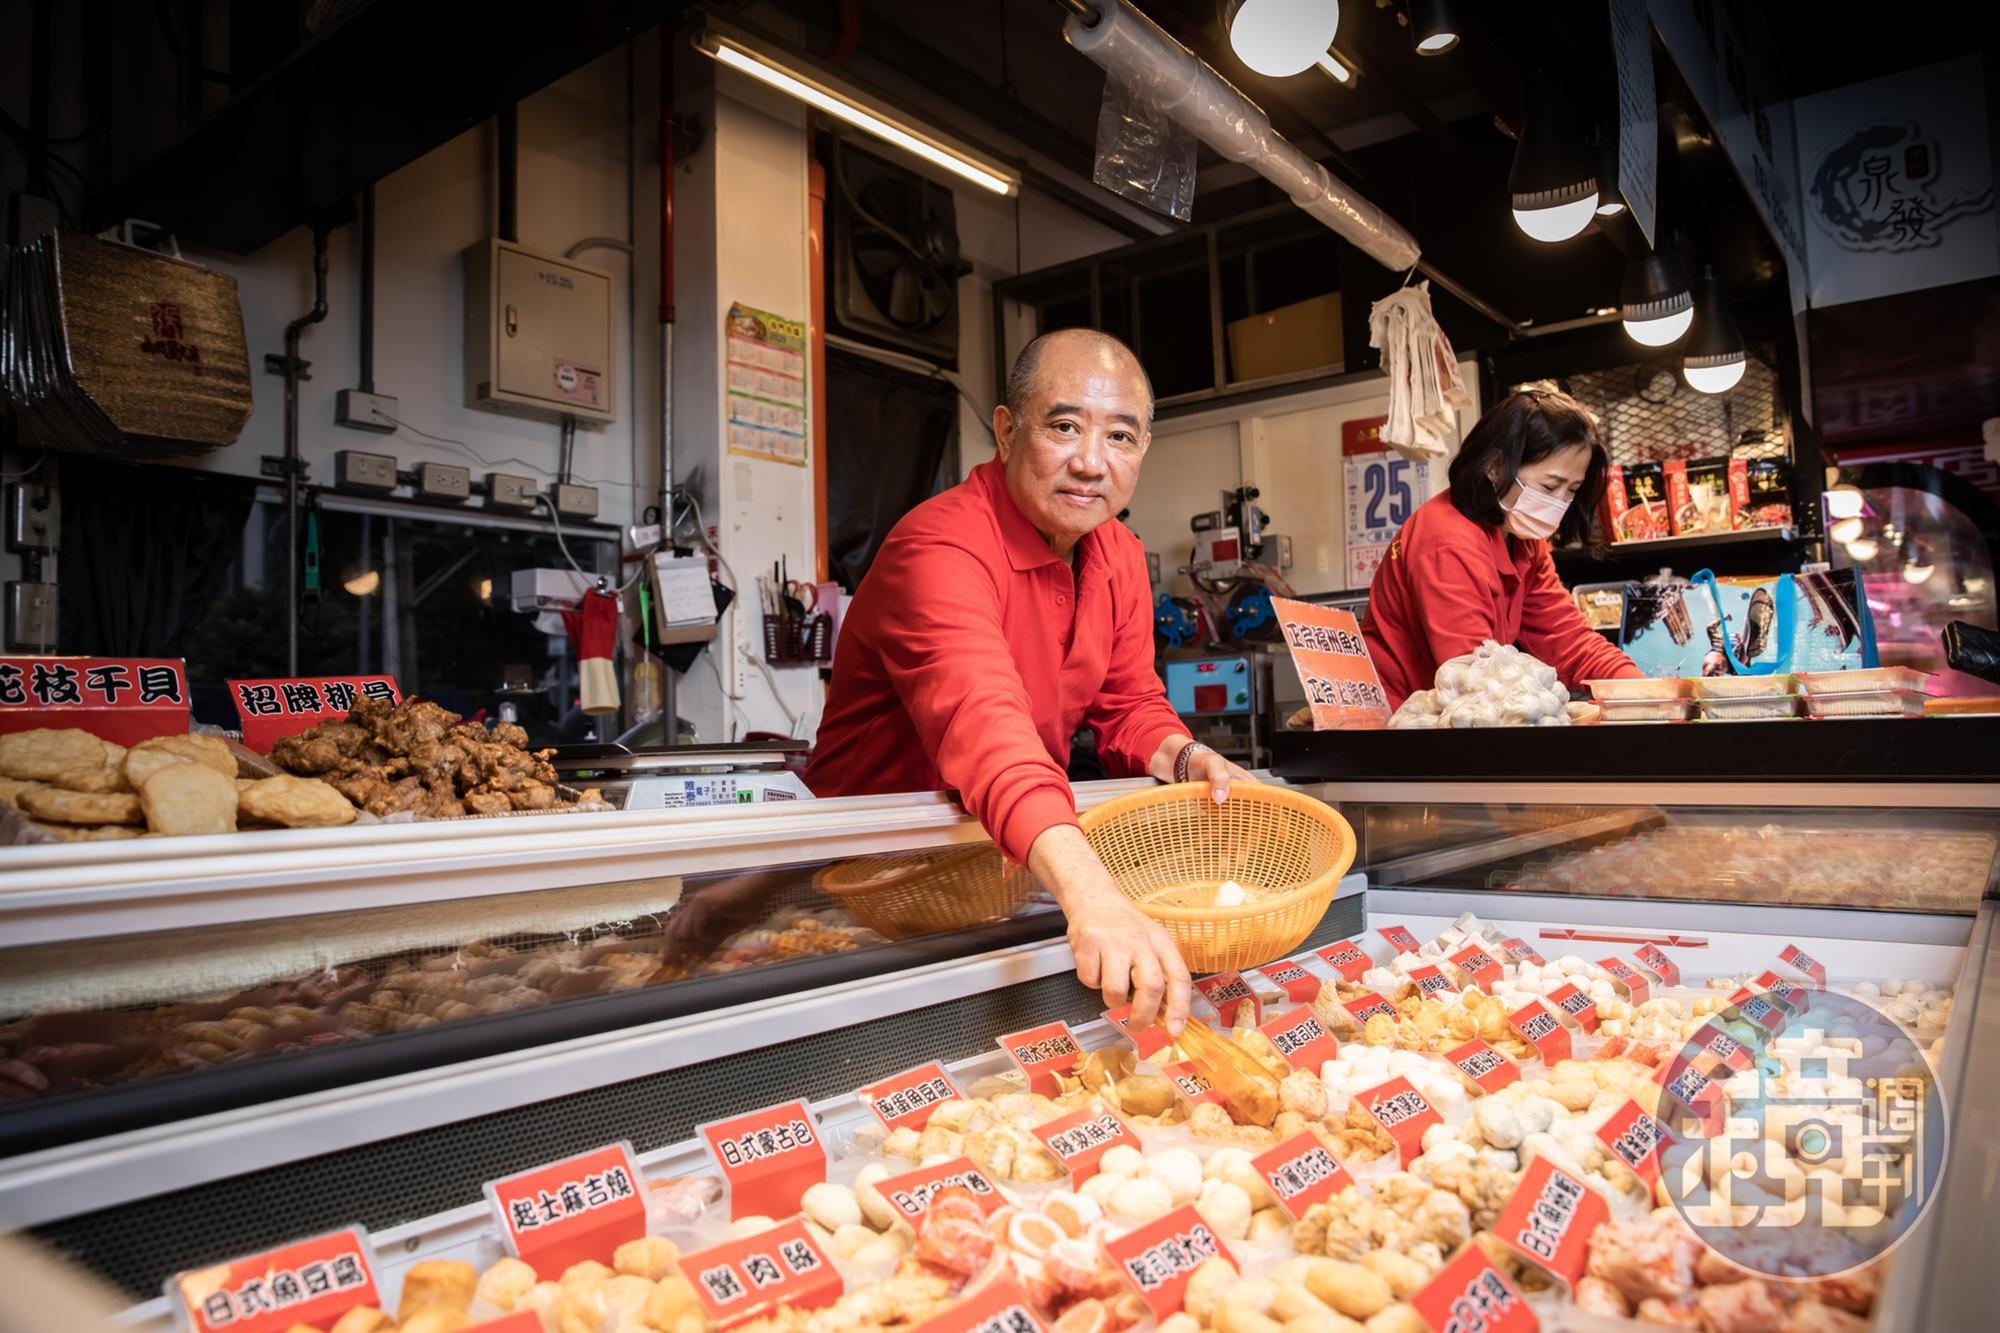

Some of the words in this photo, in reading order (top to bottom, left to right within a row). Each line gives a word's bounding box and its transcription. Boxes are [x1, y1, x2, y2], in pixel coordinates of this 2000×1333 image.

[1364, 459, 1412, 530] 25
[1286, 622, 1366, 657] 正宗福州魚丸
[0, 664, 183, 704] 花枝干貝
[1015, 1035, 1078, 1066] 明太子福袋
